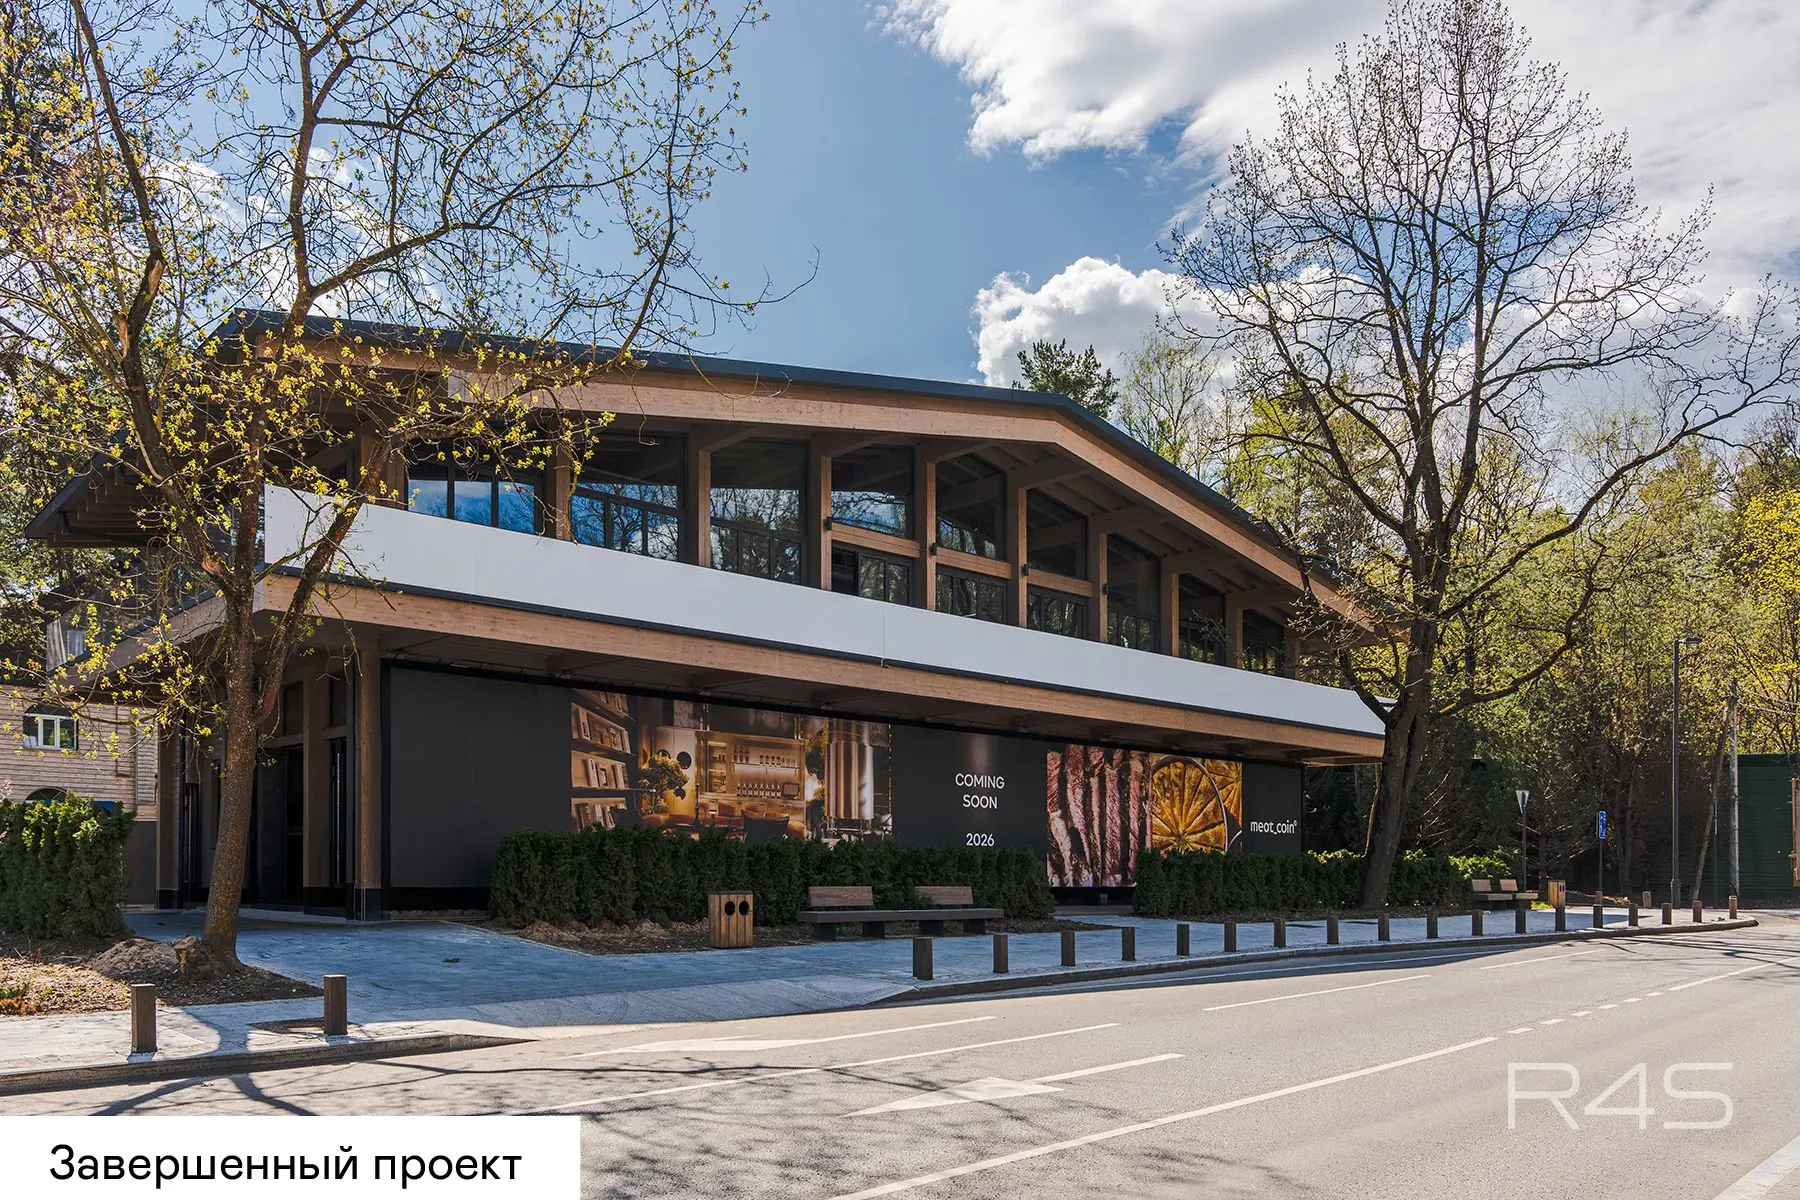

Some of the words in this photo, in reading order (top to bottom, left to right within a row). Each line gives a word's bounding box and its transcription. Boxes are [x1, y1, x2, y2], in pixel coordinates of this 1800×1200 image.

[955, 773, 1005, 789] COMING
[962, 794, 998, 809] SOON
[966, 832, 995, 847] 2026
